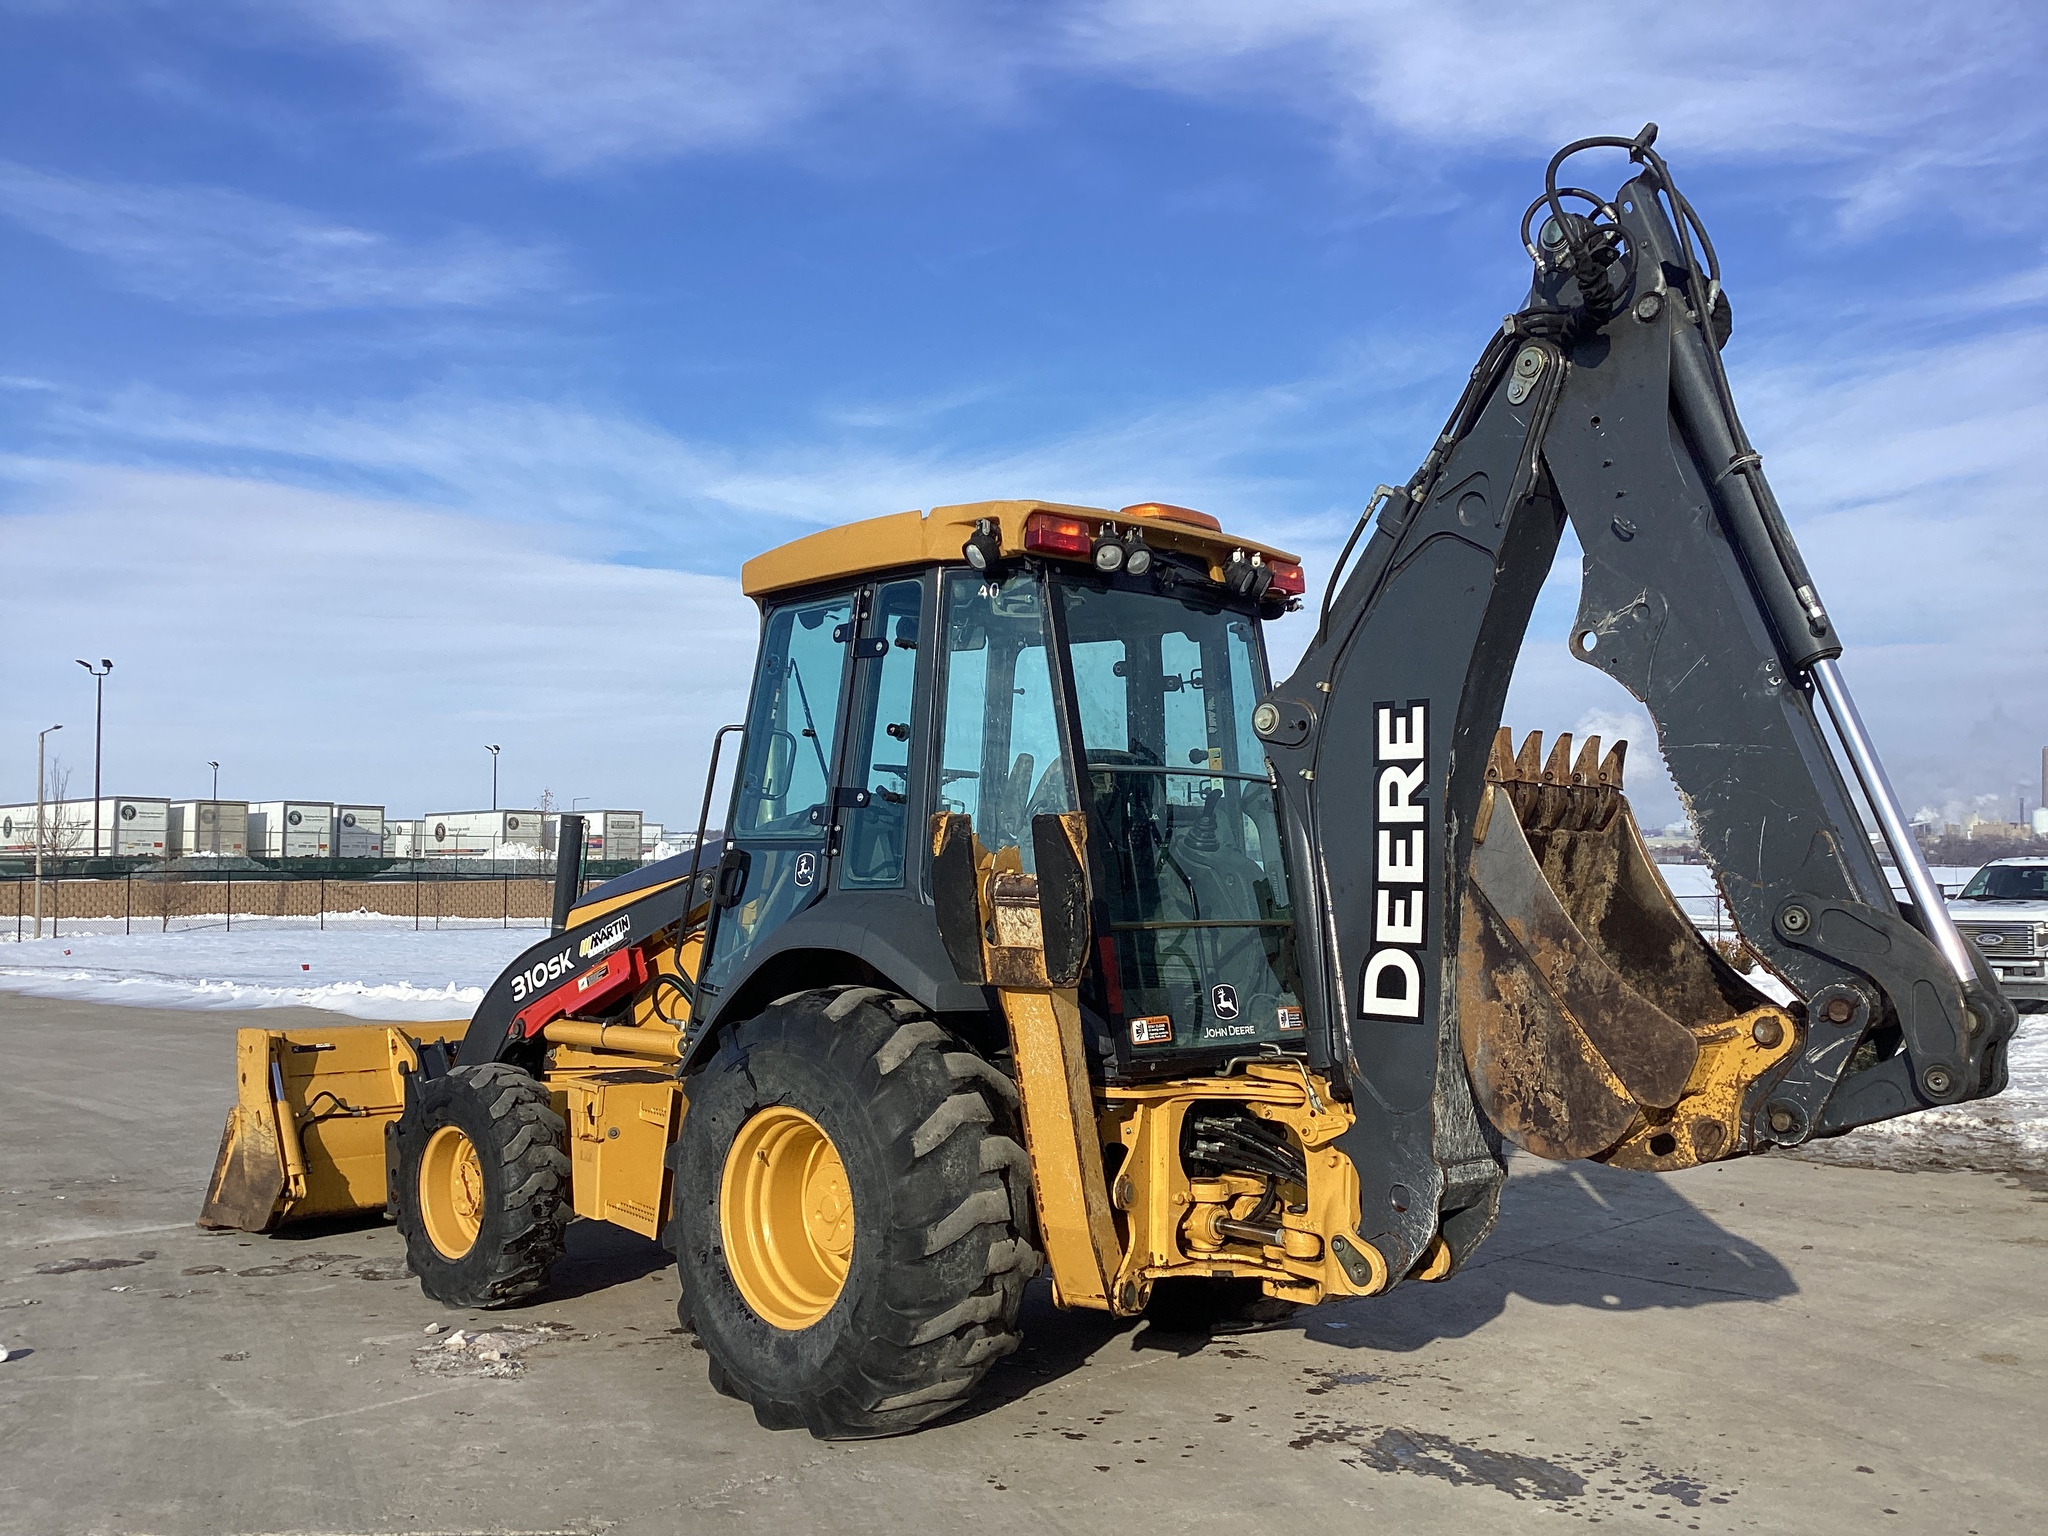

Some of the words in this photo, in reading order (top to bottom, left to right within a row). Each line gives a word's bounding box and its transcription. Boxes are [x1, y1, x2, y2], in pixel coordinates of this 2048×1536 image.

[977, 582, 1000, 600] 40
[1362, 705, 1425, 1018] DEERE
[590, 914, 630, 949] MARTIN
[510, 947, 576, 1002] 310SK
[1203, 1026, 1228, 1039] JOHN
[1227, 1025, 1256, 1036] DEERE
